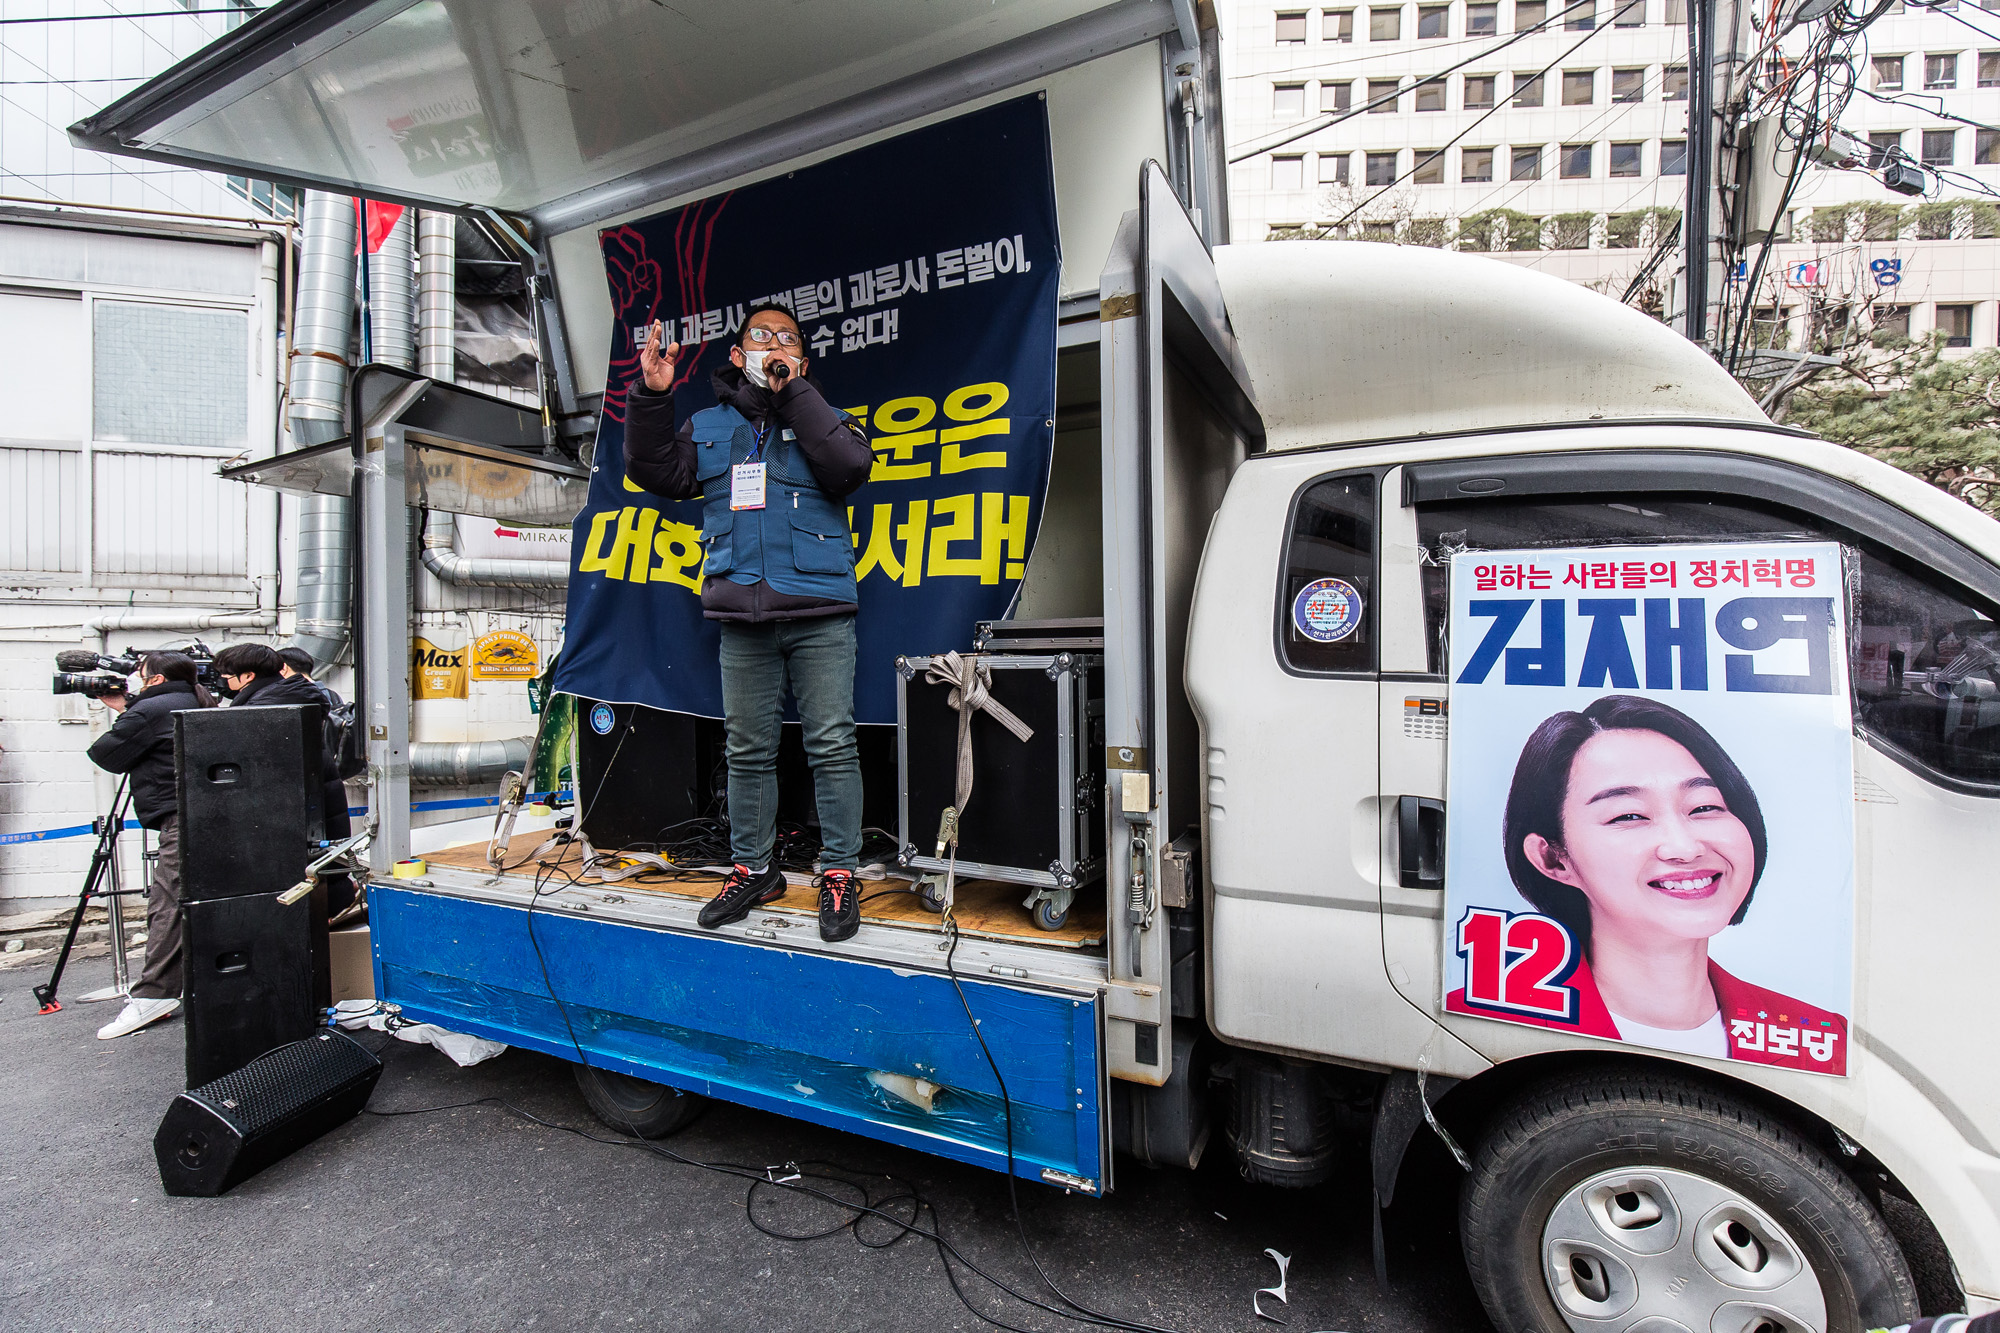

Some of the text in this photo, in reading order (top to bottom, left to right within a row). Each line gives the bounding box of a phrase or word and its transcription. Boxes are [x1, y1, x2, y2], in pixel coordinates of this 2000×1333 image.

[681, 303, 746, 346] 과로사
[848, 256, 930, 308] 과로사
[936, 234, 1032, 289] 돈벌이,
[1871, 258, 1901, 286] 영
[811, 308, 899, 357] 수 없다!
[843, 381, 1011, 483] 운은
[847, 493, 1030, 588] 서라!
[1473, 557, 1817, 591] 일하는 사람들의 정치혁명
[1307, 601, 1346, 620] 선거
[413, 648, 462, 667] Max
[499, 633, 519, 643] PRIME
[1455, 597, 1836, 695] 김재연
[431, 677, 445, 690] 生
[1457, 906, 1575, 1022] 12
[1730, 1018, 1839, 1061] 진보당
